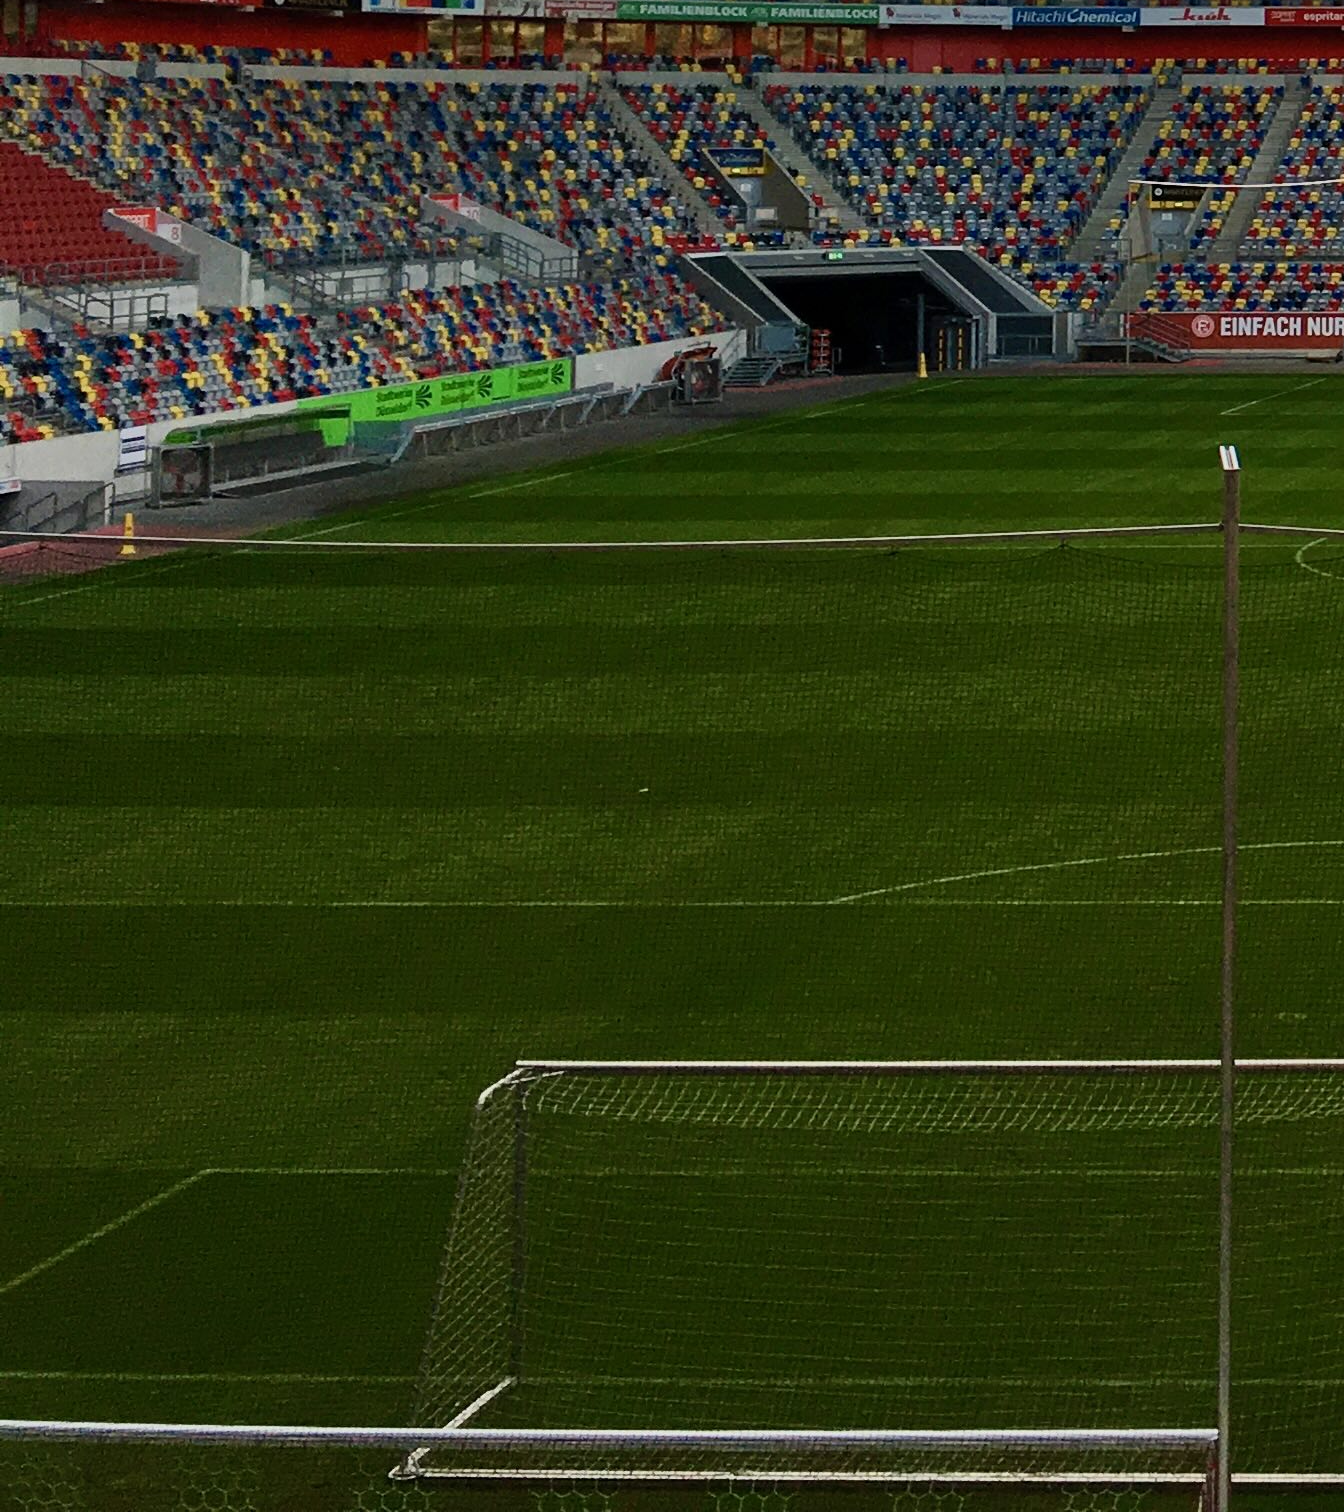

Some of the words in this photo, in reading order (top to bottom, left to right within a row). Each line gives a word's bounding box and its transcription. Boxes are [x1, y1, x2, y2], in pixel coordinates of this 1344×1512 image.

[639, 4, 748, 18] FAMILIENBLOCK
[770, 8, 878, 20] FAMILIENBLOCK
[1016, 10, 1066, 22] Hitachi
[1067, 8, 1136, 23] Chemical
[171, 226, 180, 240] 8
[1221, 316, 1301, 337] EINFACH
